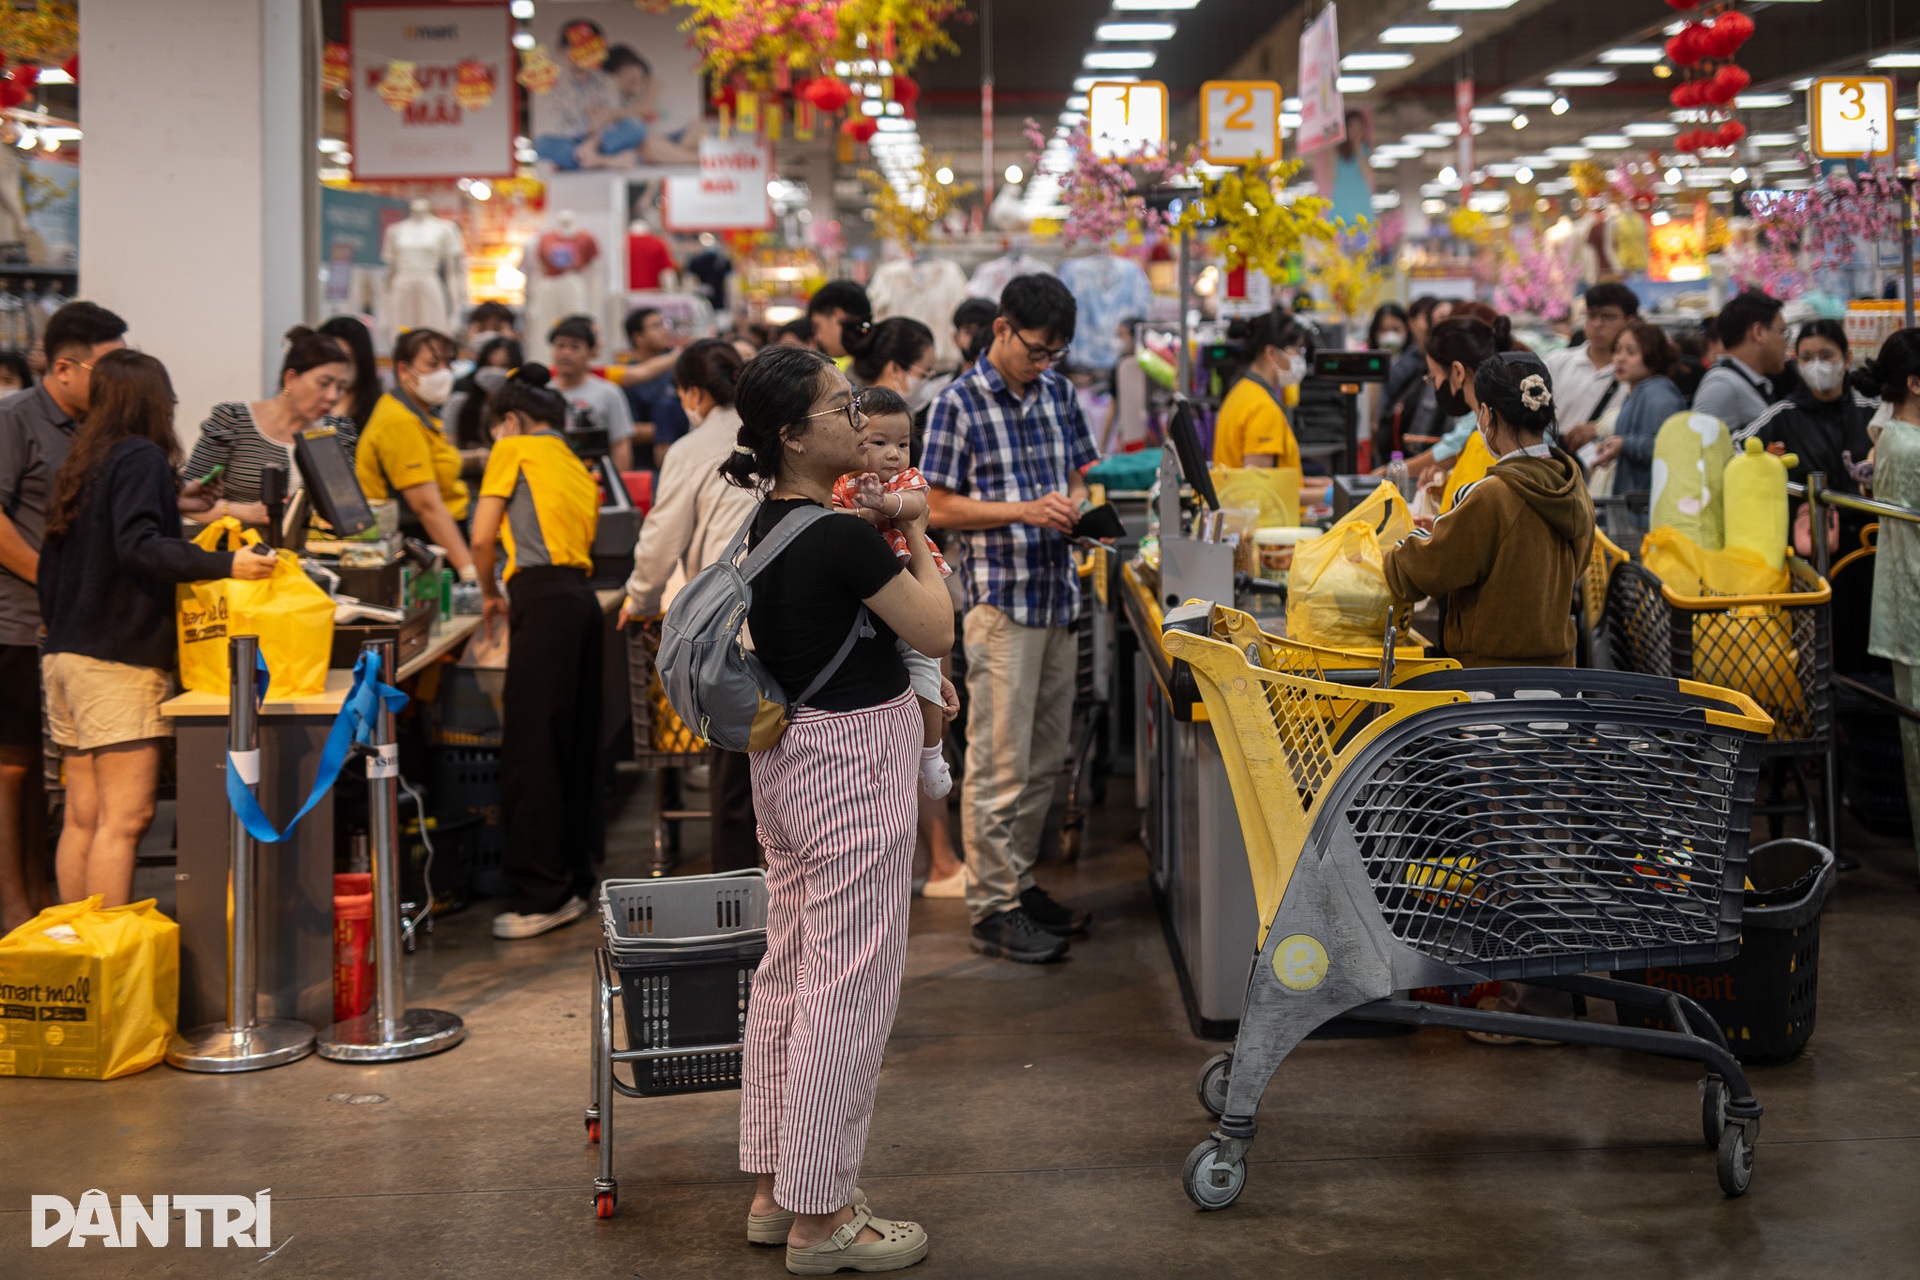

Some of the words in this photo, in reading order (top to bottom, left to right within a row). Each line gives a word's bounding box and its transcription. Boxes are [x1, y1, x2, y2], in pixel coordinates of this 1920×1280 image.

[1115, 85, 1131, 126] 1
[1223, 84, 1256, 131] 2
[1838, 80, 1866, 121] 3
[0, 983, 42, 1002] mart
[46, 976, 91, 1004] mall
